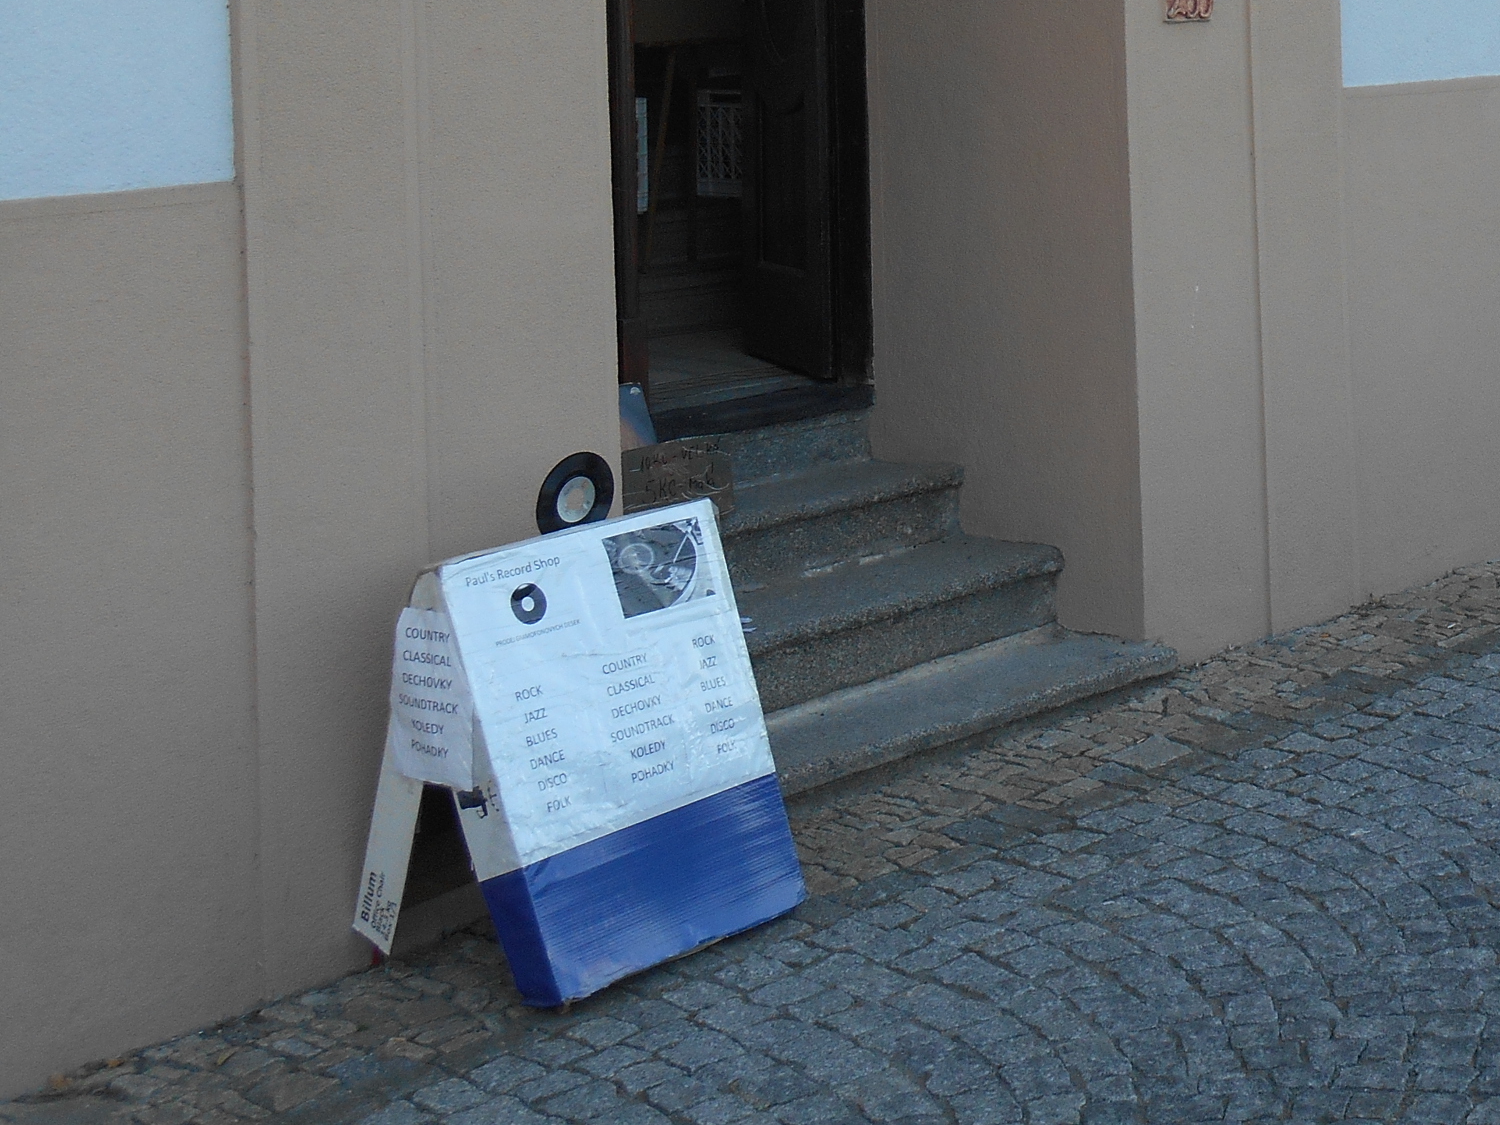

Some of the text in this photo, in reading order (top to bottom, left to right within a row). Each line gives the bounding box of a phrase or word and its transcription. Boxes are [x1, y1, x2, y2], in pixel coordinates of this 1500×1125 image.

[465, 555, 561, 587] Paul's Record Shop
[405, 627, 450, 644] COUNTRY
[691, 634, 716, 649] ROCK
[403, 650, 452, 667] CLASSICAL
[601, 653, 648, 675] COUNTRY
[699, 655, 718, 670] JAZZ
[402, 672, 453, 690] DECHOVKY
[606, 674, 656, 697] CLASSICAL
[700, 675, 727, 692] BLUES
[514, 685, 544, 702] ROCK
[398, 693, 459, 715] SOUNDTRACK
[611, 695, 662, 719] DECHOVKY
[704, 696, 734, 713] DANCE
[524, 707, 548, 724] JAZZ
[410, 718, 445, 735] KOLEDY
[610, 714, 676, 743] SOUNDTRACK
[710, 718, 736, 734] DISCO
[525, 727, 559, 747] BLUES
[410, 738, 449, 758] POHADKY
[629, 740, 667, 759] KOLEDY
[716, 740, 737, 754] FOLK
[529, 749, 566, 770] DANCE
[630, 760, 675, 783] POHADKY
[537, 772, 568, 792] DISCO
[546, 795, 572, 813] FOLK
[360, 871, 377, 923] Billum
